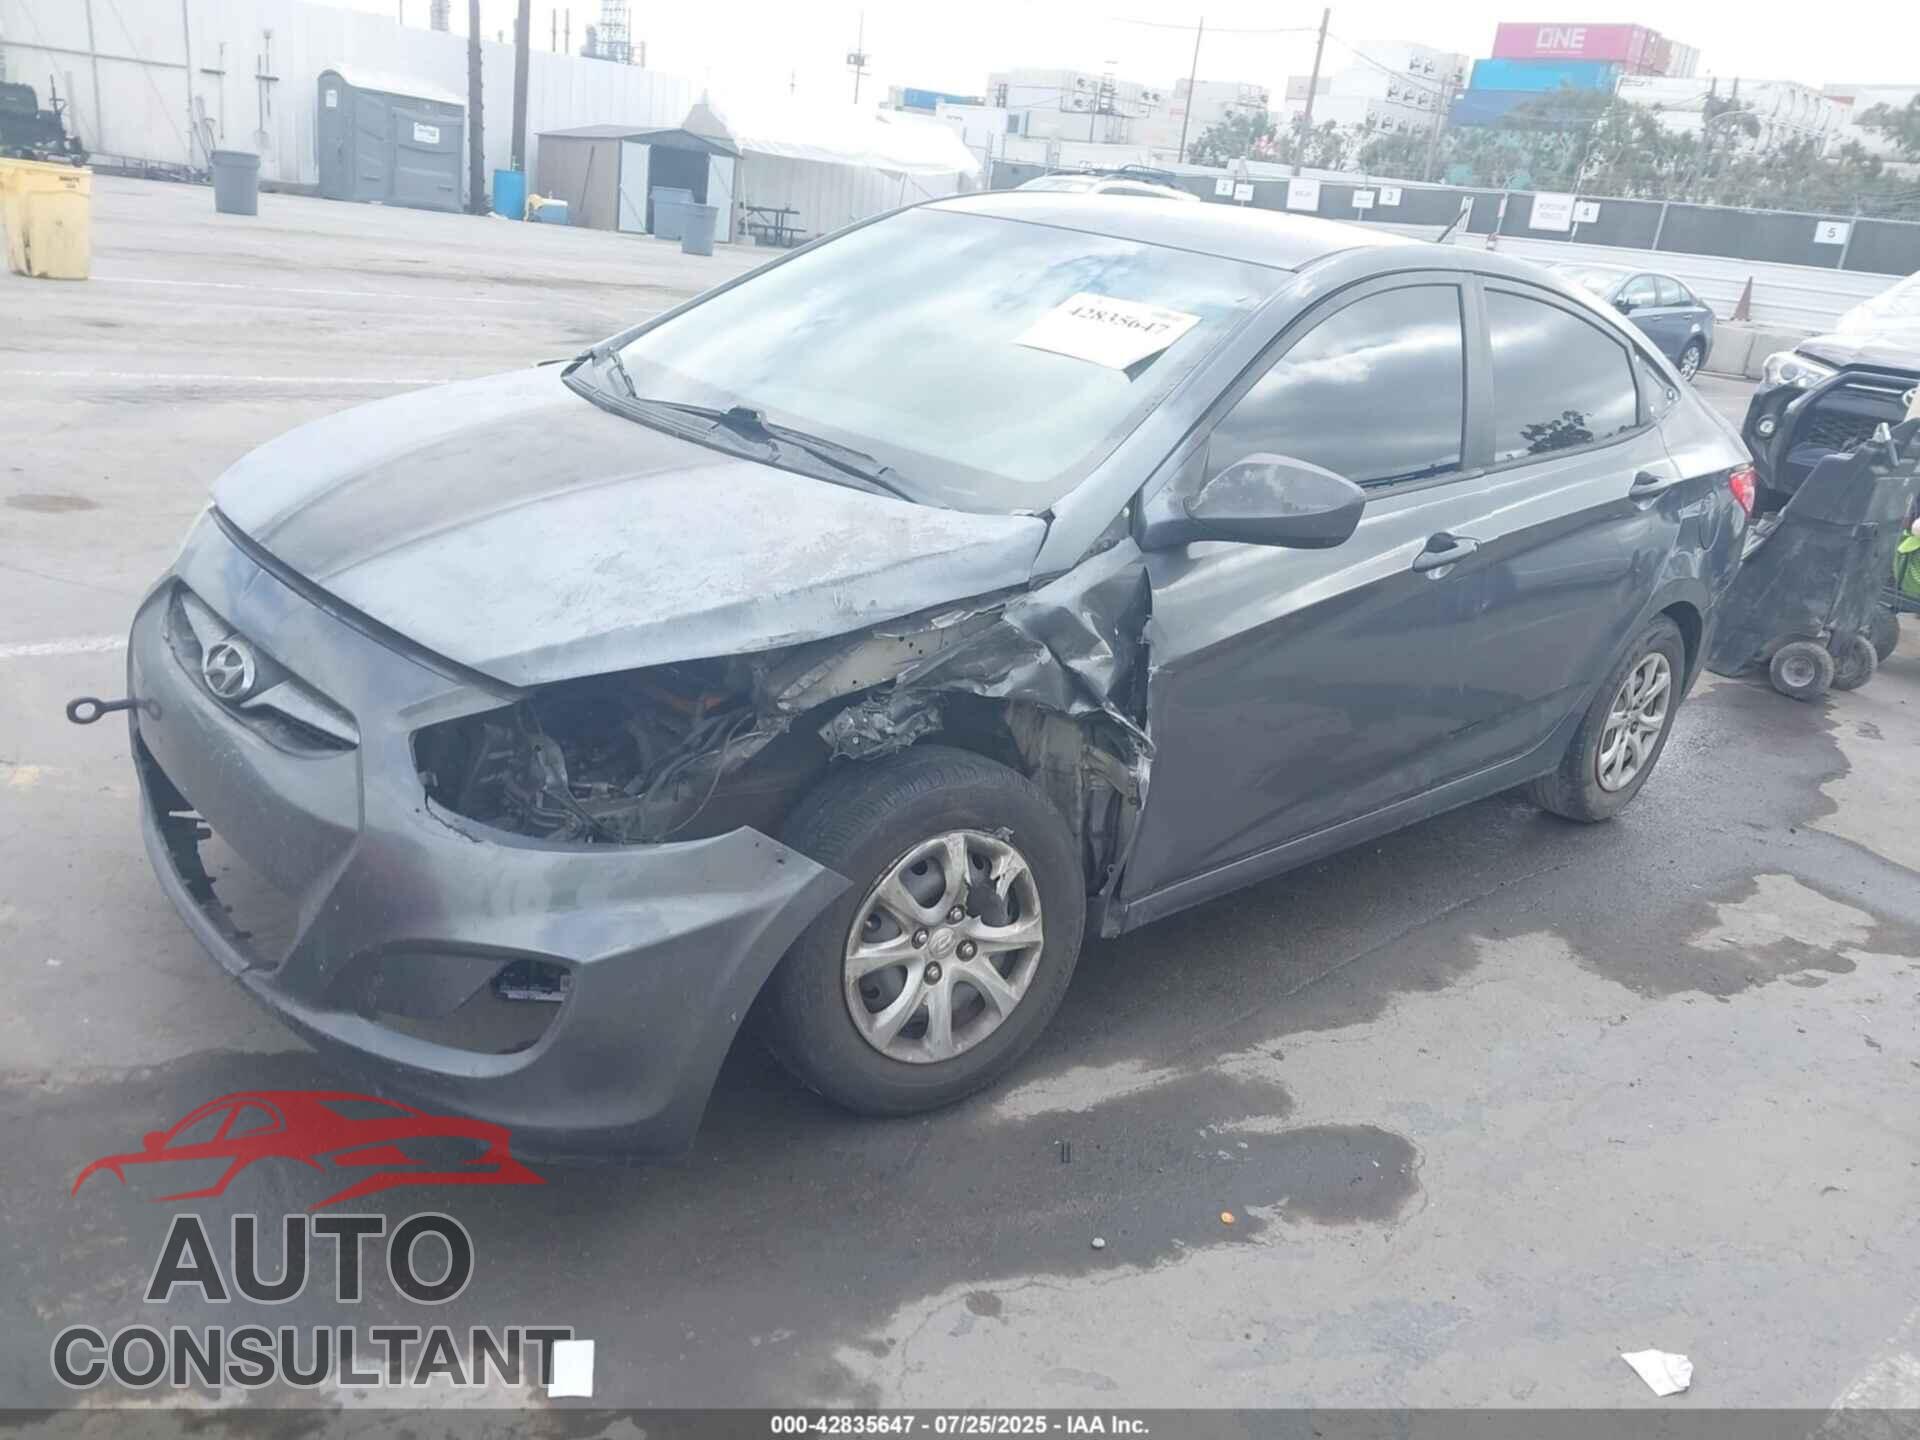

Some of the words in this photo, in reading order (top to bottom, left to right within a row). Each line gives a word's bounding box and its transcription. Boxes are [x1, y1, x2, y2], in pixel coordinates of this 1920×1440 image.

[1536, 28, 1586, 49] ONE
[1826, 227, 1837, 239] 5
[1070, 304, 1170, 334] 42835647
